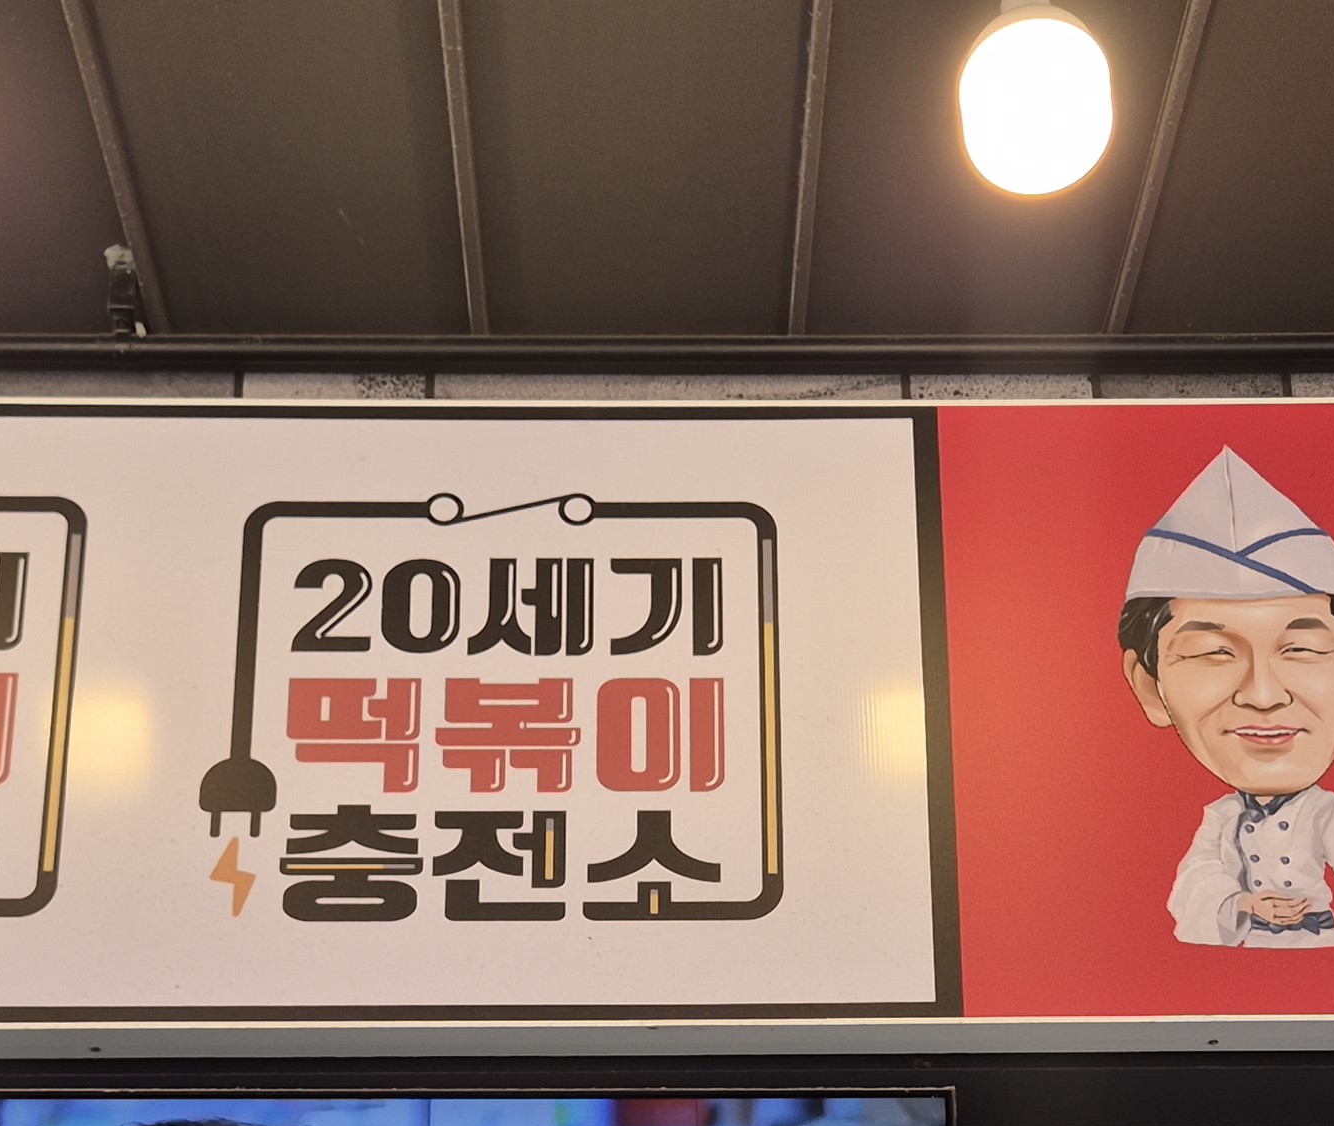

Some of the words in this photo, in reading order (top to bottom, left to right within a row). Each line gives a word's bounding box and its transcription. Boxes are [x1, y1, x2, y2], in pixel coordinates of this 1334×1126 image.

[290, 557, 725, 656] 20세기
[286, 677, 726, 793] 떡볶이
[279, 804, 723, 921] 충전소
